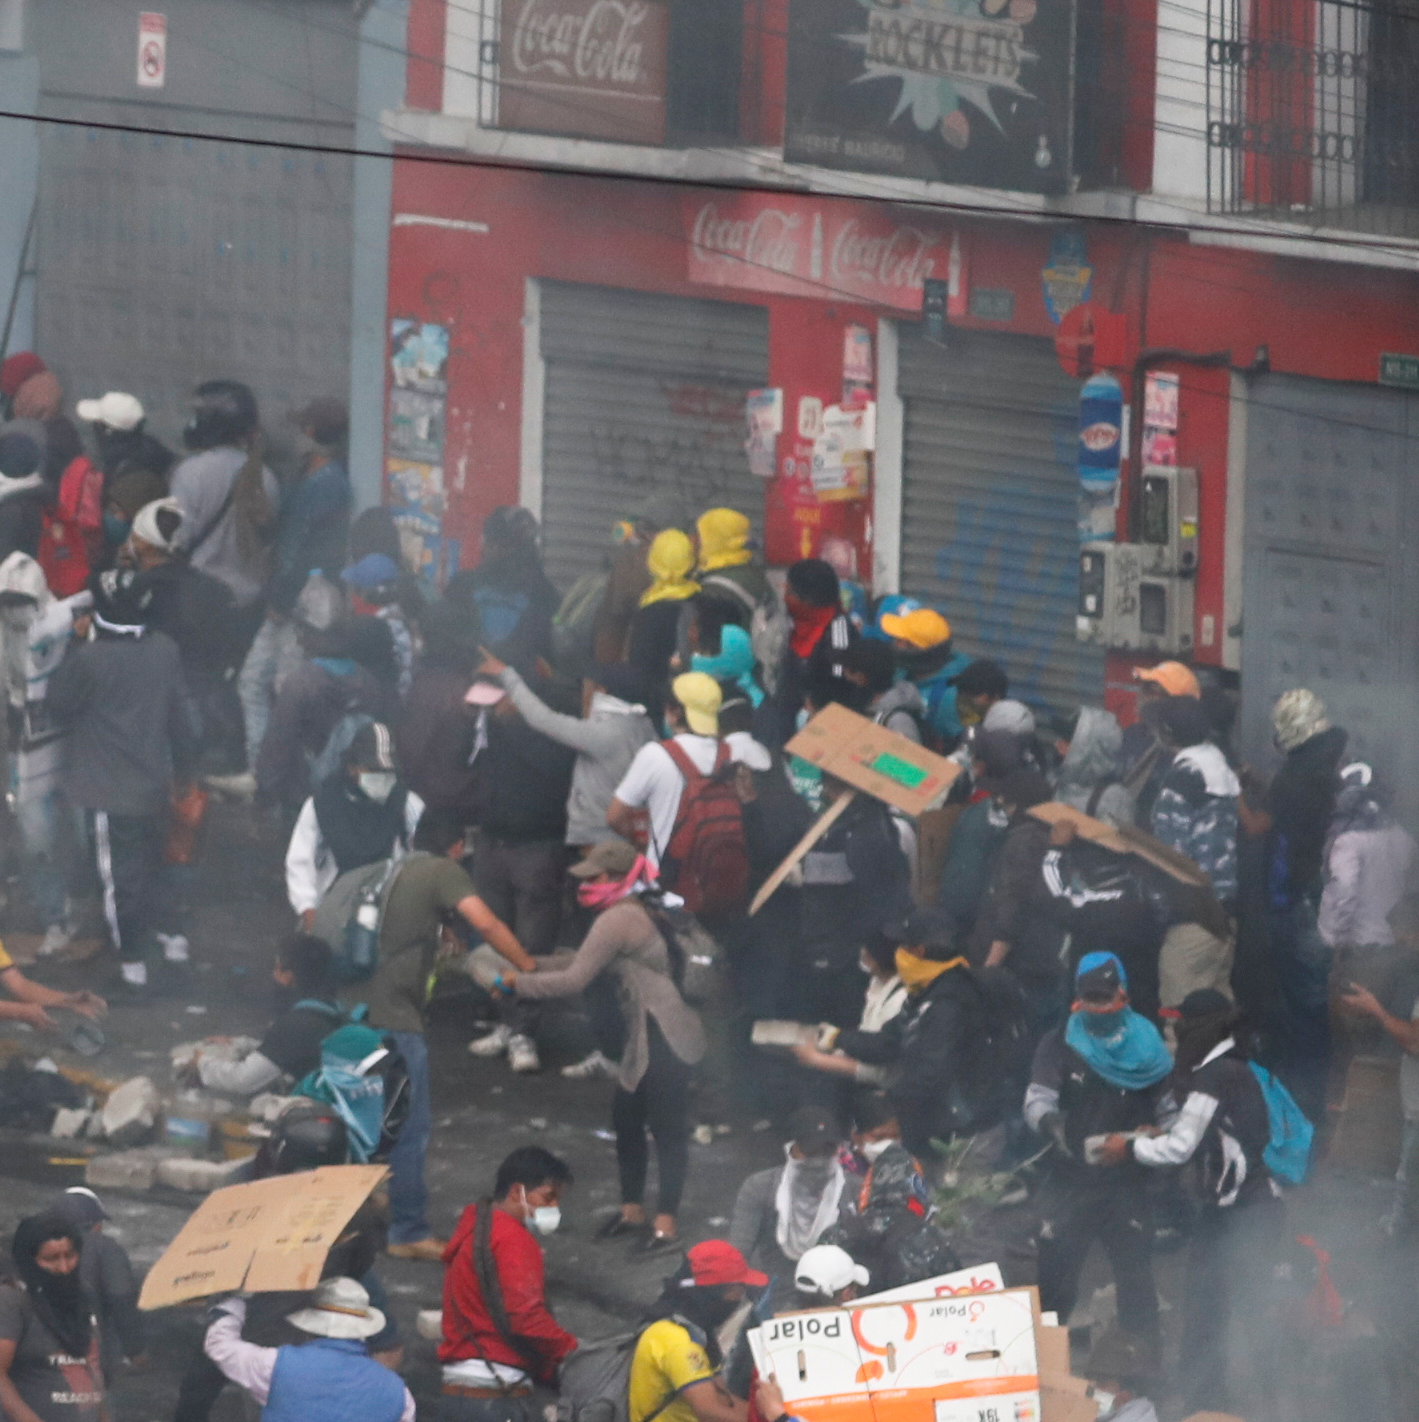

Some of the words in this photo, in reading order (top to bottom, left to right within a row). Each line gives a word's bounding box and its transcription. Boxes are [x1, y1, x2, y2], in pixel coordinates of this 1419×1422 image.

[866, 13, 1023, 80] ROCKLETS
[929, 1301, 967, 1319] Polar
[770, 1315, 842, 1342] Polar
